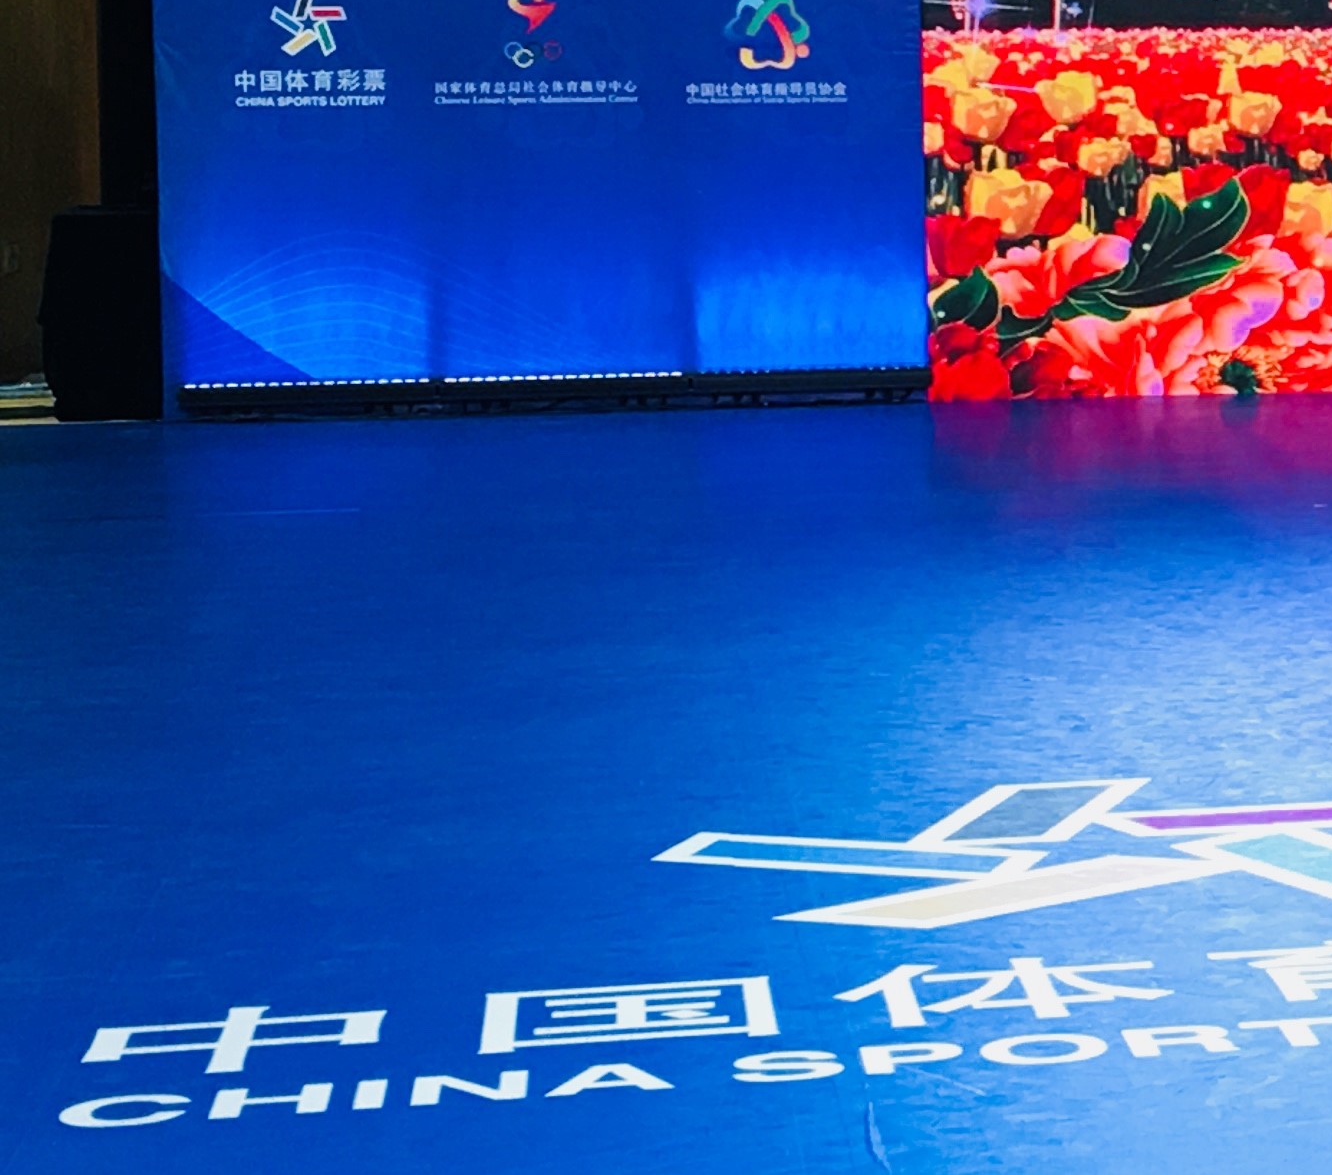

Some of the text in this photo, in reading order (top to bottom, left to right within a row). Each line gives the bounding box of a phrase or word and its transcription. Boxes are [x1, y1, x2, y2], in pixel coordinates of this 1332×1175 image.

[234, 69, 387, 93] 中国体育彩票
[235, 94, 387, 107] CHINA SPORTS LOTTERY
[58, 1062, 676, 1129] CHINA
